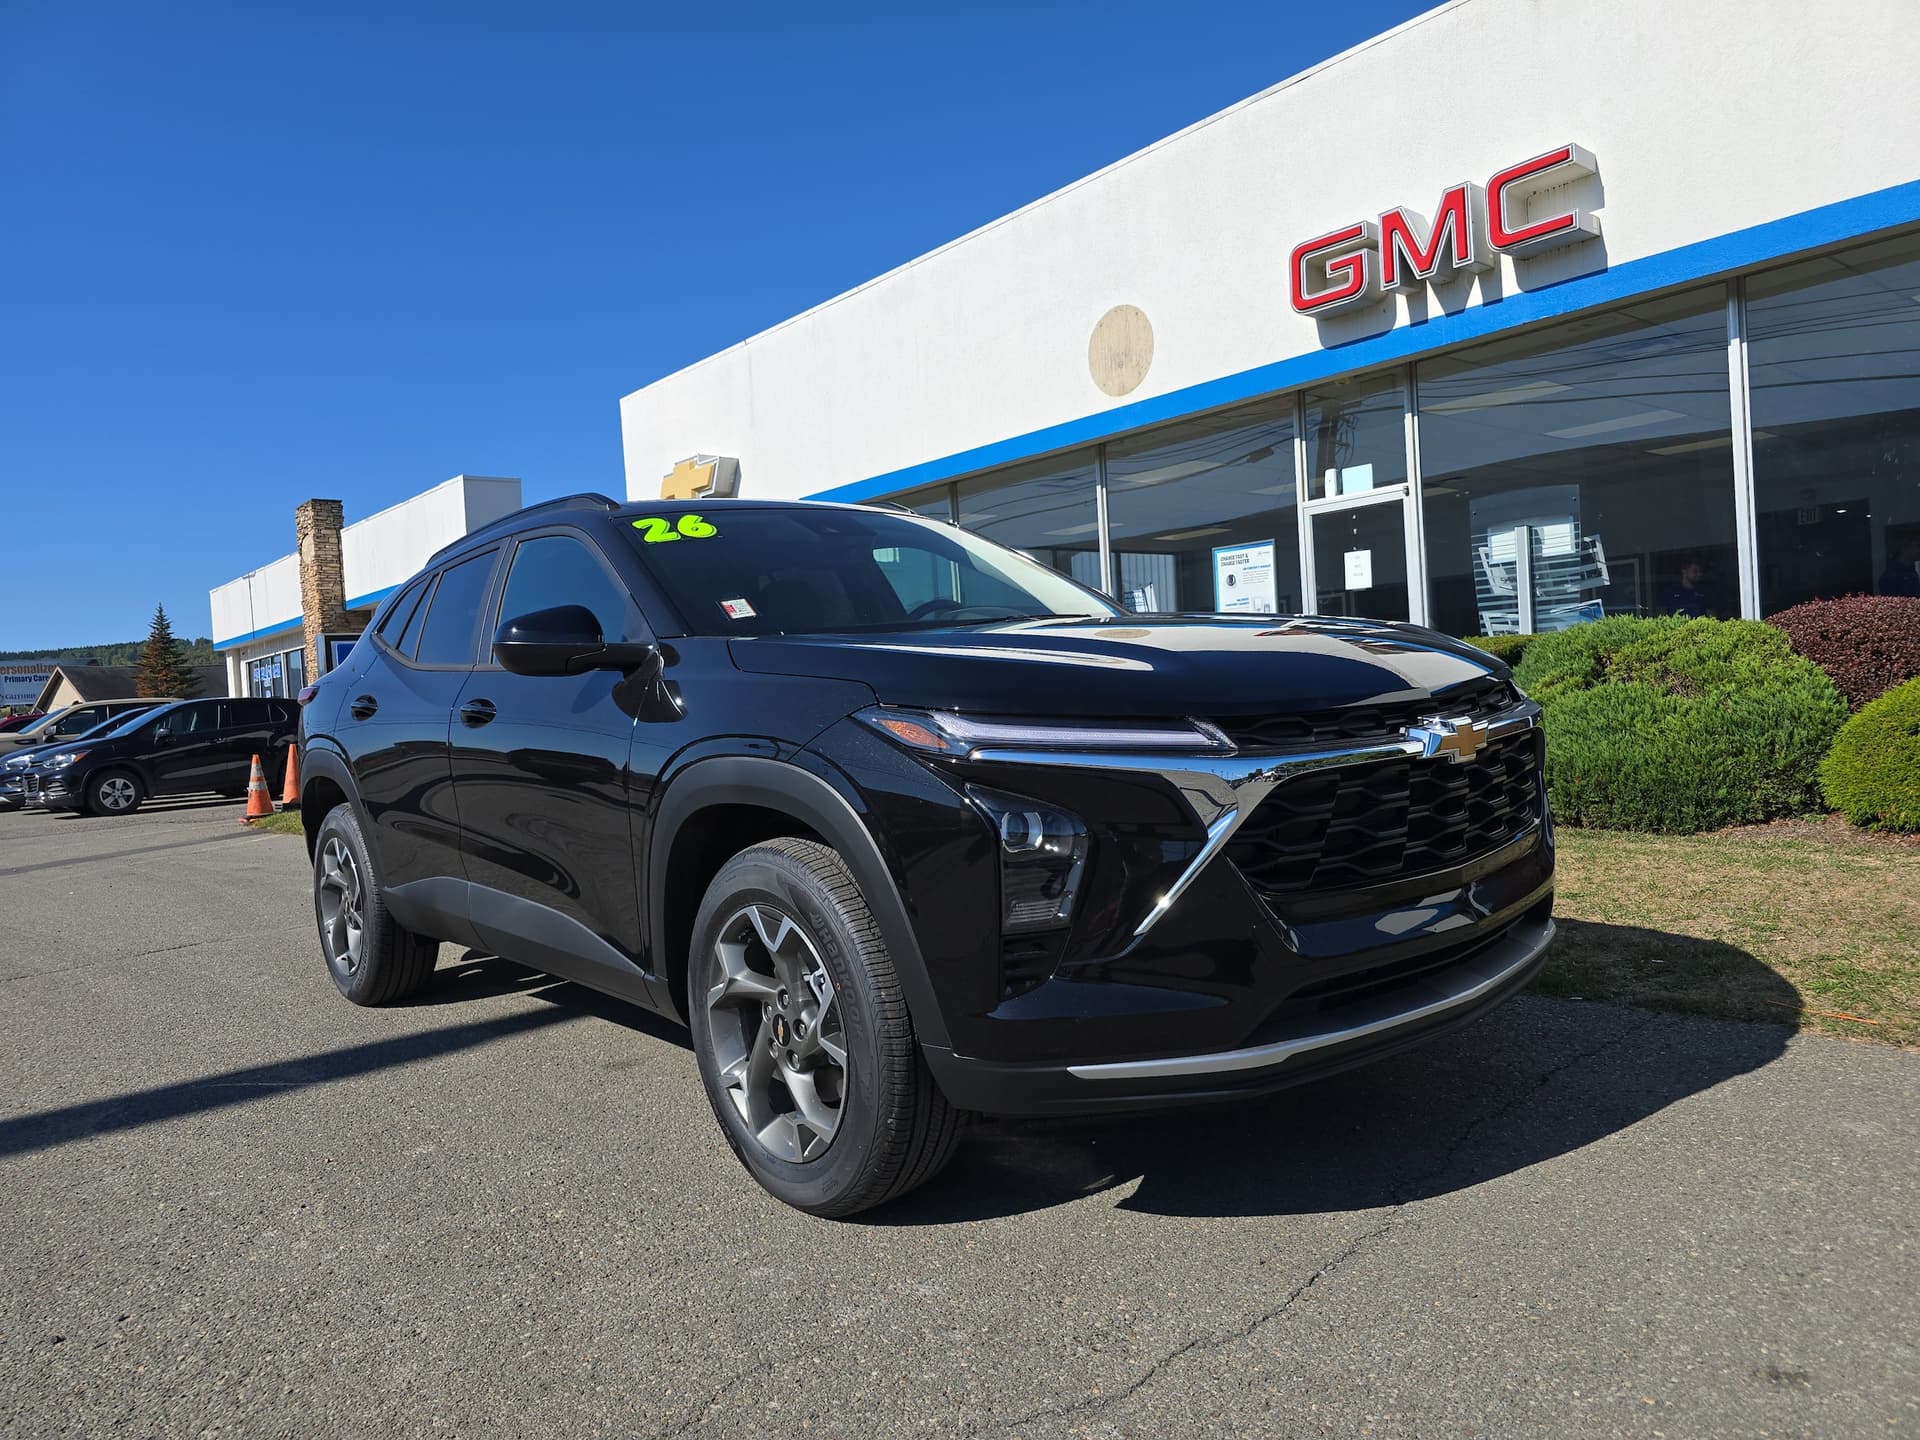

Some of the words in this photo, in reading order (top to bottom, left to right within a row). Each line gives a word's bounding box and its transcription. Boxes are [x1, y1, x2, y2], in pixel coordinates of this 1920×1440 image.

[1290, 143, 1588, 315] GMC
[632, 515, 718, 543] 26
[4, 675, 32, 683] Primary
